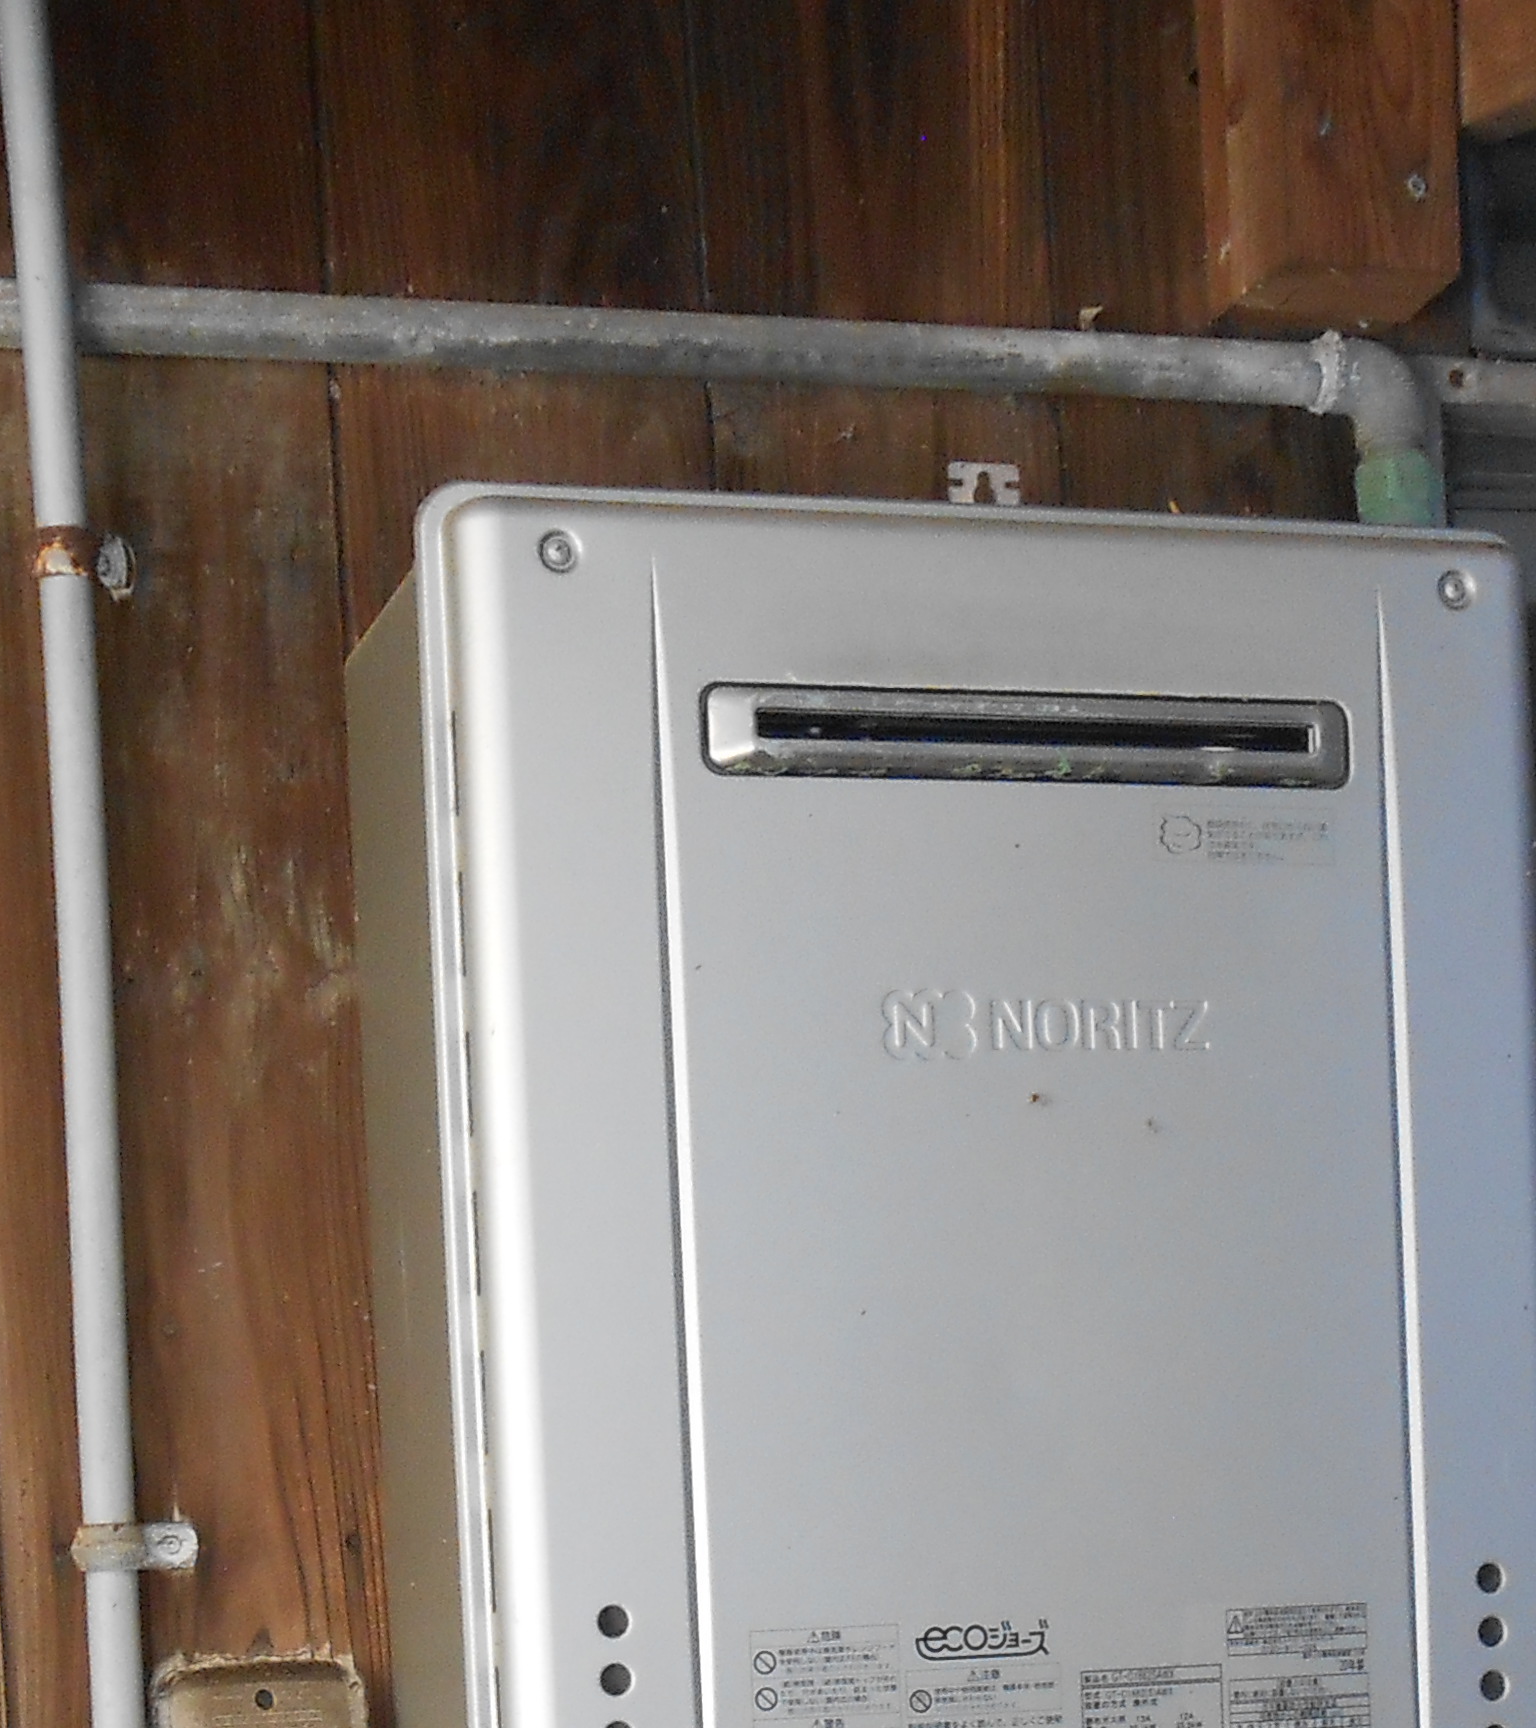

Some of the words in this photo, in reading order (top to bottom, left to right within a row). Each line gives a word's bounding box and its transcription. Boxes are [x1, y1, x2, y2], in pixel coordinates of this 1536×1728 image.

[989, 998, 1211, 1052] NORITZ
[915, 1618, 1050, 1661] ecoジョーズ
